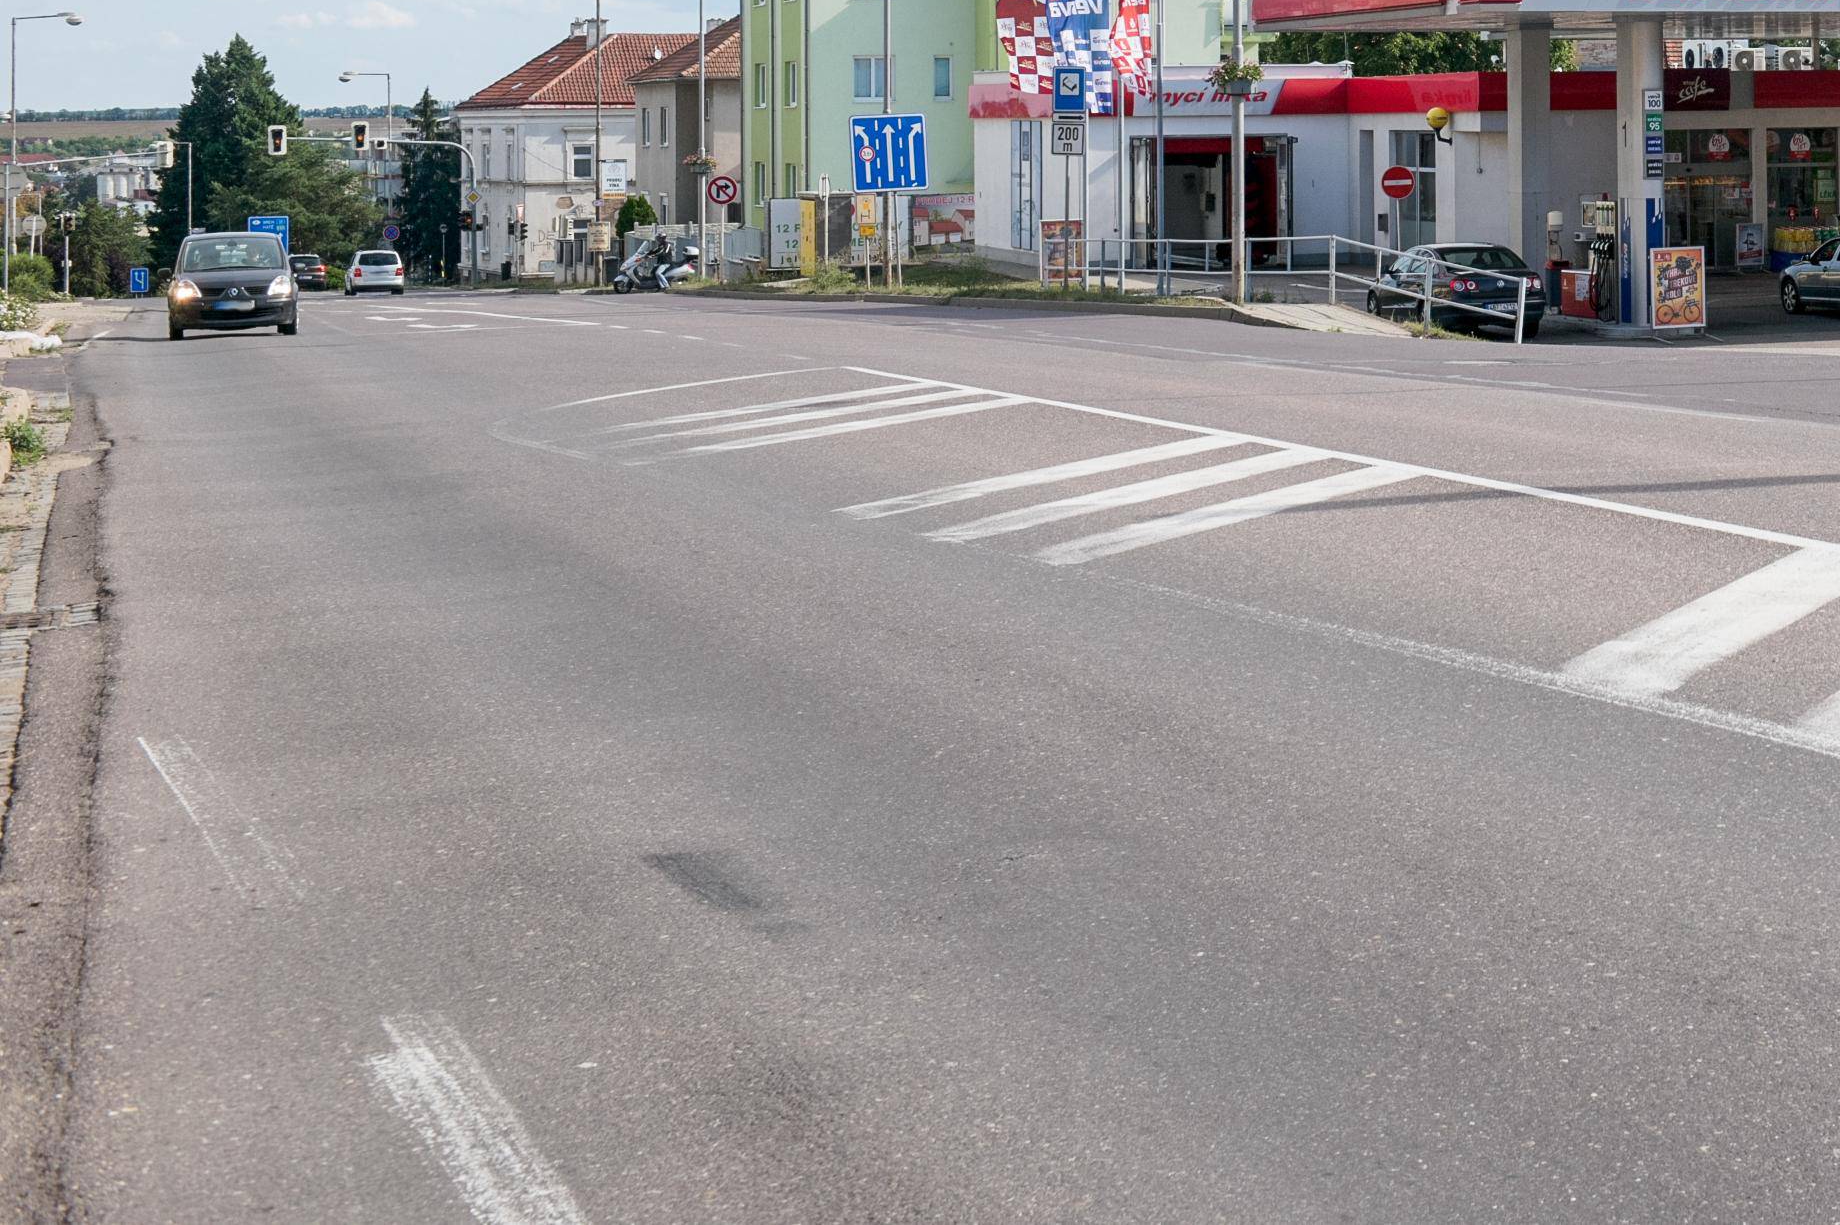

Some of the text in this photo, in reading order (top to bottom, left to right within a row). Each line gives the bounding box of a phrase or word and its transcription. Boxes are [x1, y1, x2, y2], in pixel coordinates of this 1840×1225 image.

[1648, 100, 1661, 108] 100
[1649, 122, 1660, 131] 95
[1057, 127, 1079, 141] 200
[1622, 121, 1627, 148] 1
[1063, 142, 1073, 152] m
[776, 224, 790, 233] 12
[785, 239, 798, 248] 12
